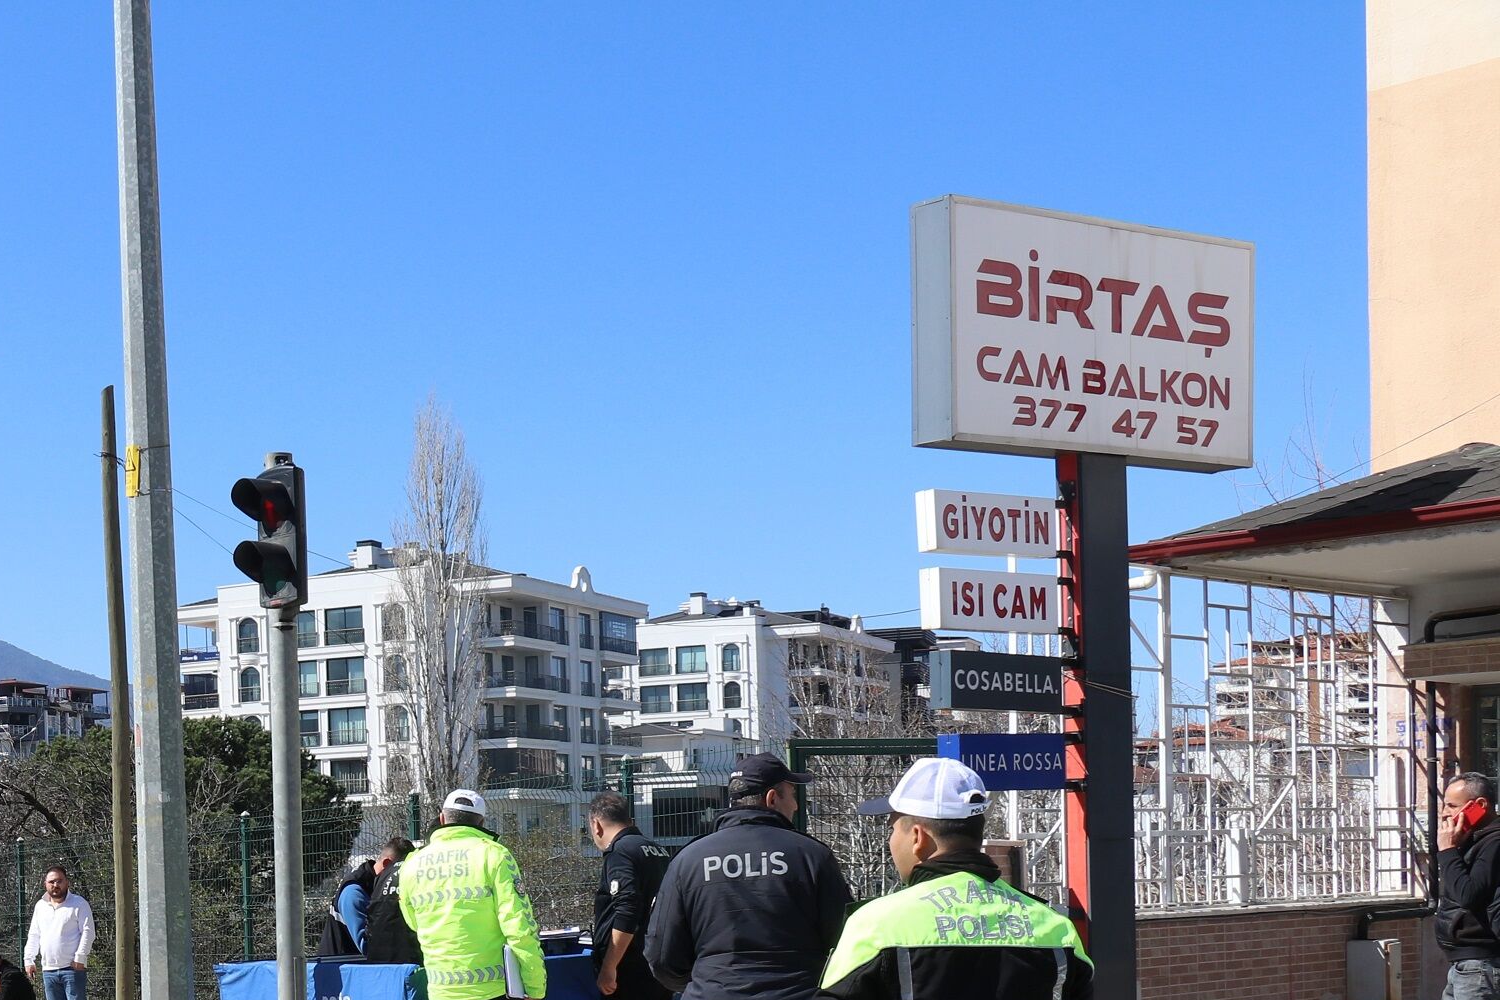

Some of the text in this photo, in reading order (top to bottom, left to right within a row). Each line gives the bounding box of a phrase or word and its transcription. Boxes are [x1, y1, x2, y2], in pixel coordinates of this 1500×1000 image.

[976, 249, 1231, 358] BİRTAŞ
[977, 345, 1231, 411] CAM BALKON
[1012, 395, 1219, 447] 377 47 57
[943, 494, 1049, 545] GİYOTİN
[952, 581, 1047, 620] ISI CAM
[955, 669, 1059, 695] COSABELLA.
[1013, 752, 1063, 772] ROSSA
[416, 863, 470, 884] POLİSİ
[418, 848, 470, 868] TRAFİK
[703, 851, 789, 882] POLİS
[935, 915, 1035, 940] POLİSİ
